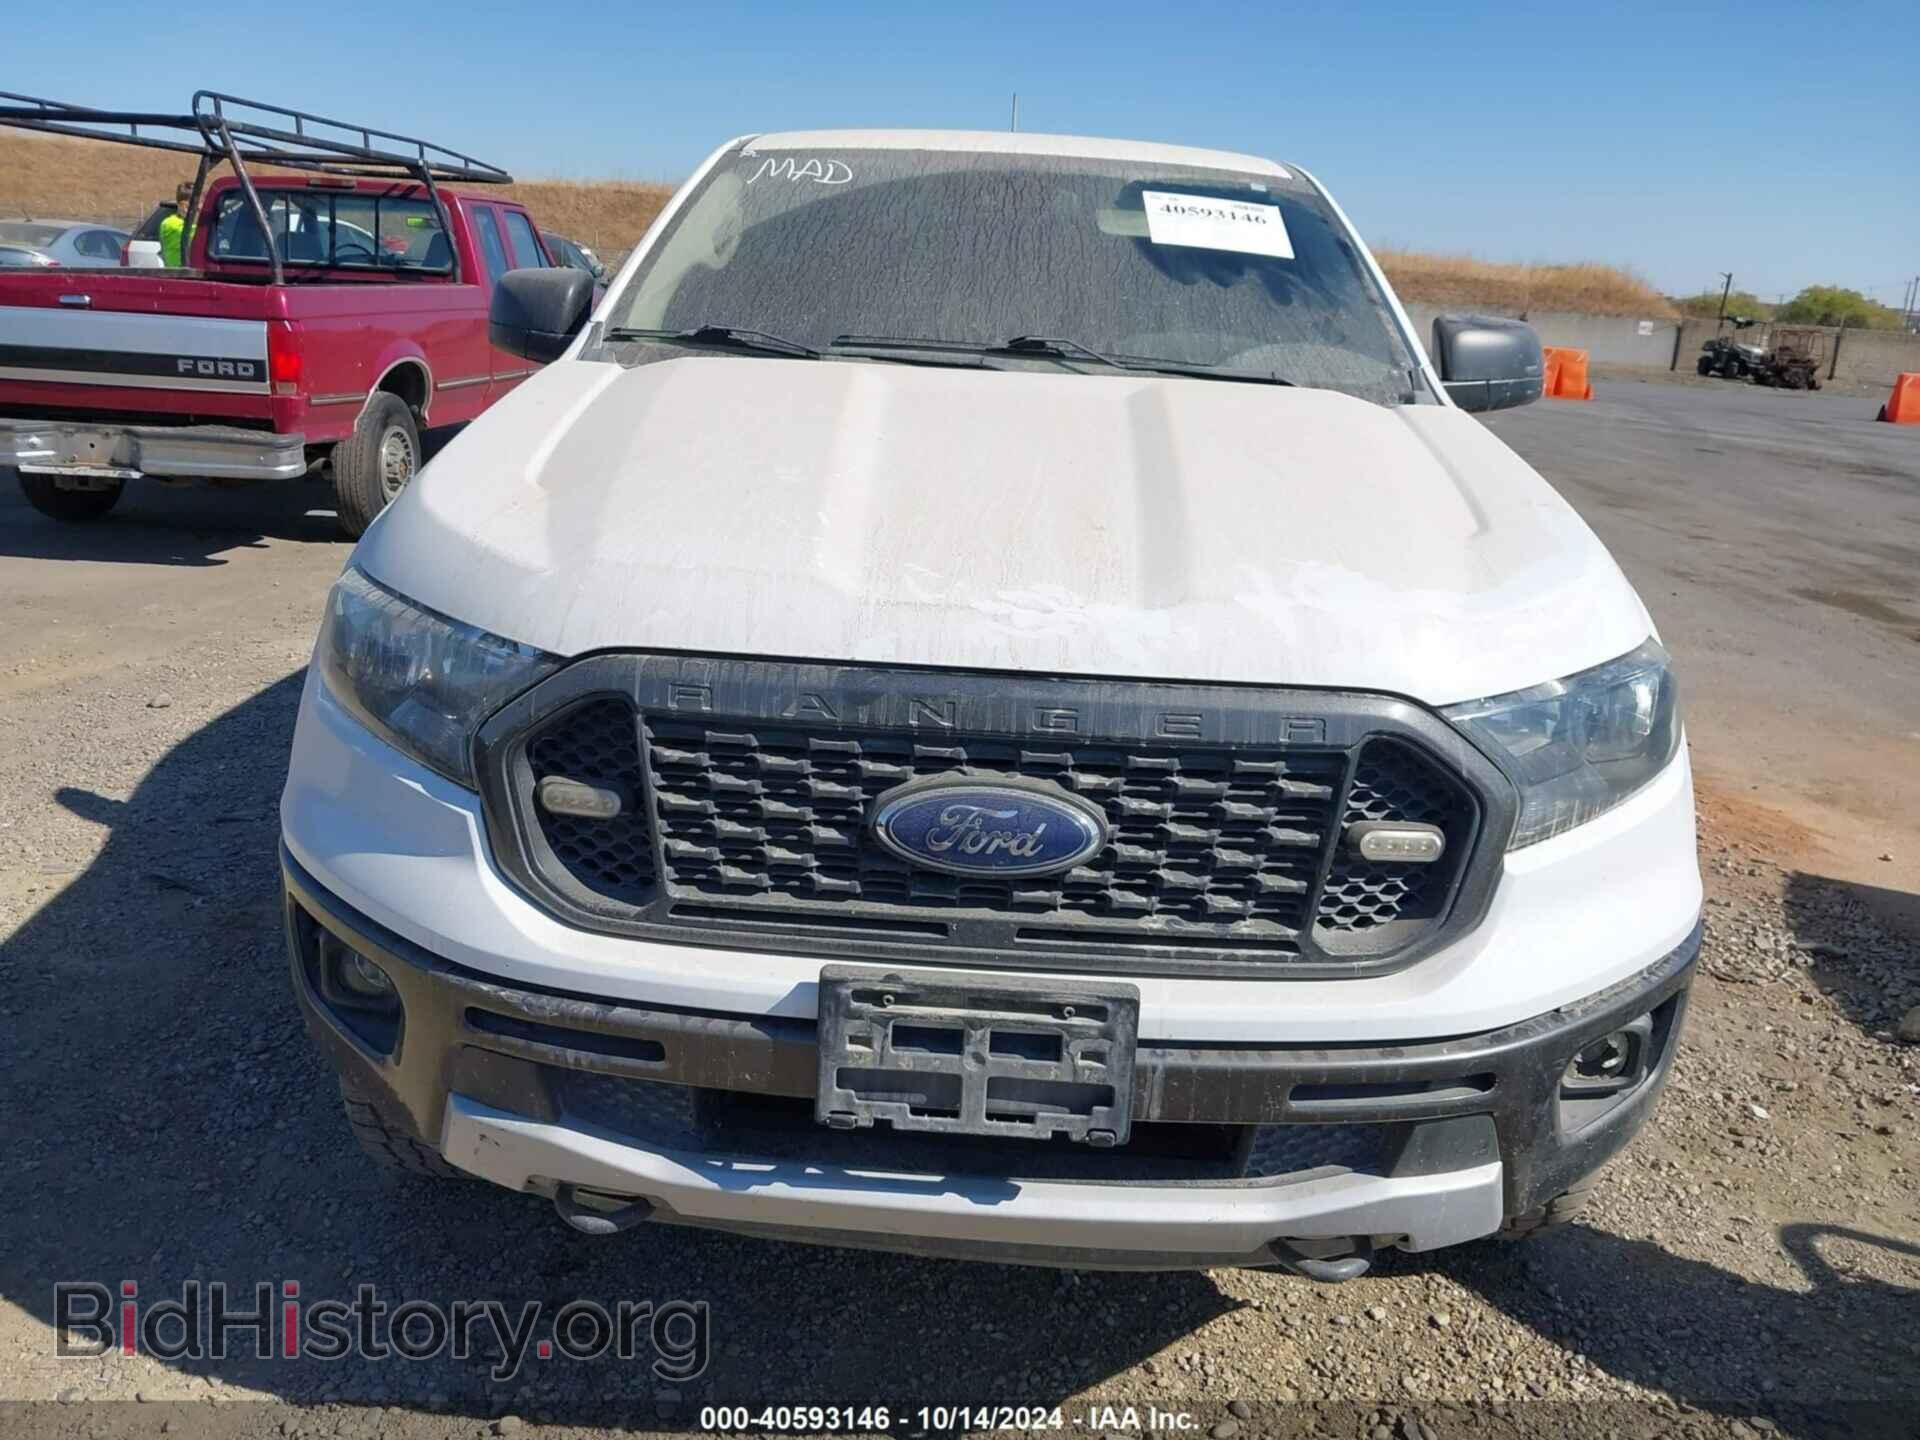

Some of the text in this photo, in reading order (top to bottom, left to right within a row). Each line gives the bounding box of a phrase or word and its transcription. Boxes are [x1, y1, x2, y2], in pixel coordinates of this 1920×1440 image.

[747, 158, 853, 184] MAD
[178, 358, 255, 377] FORD
[667, 683, 1327, 744] RANGER
[925, 804, 1048, 857] Ford
